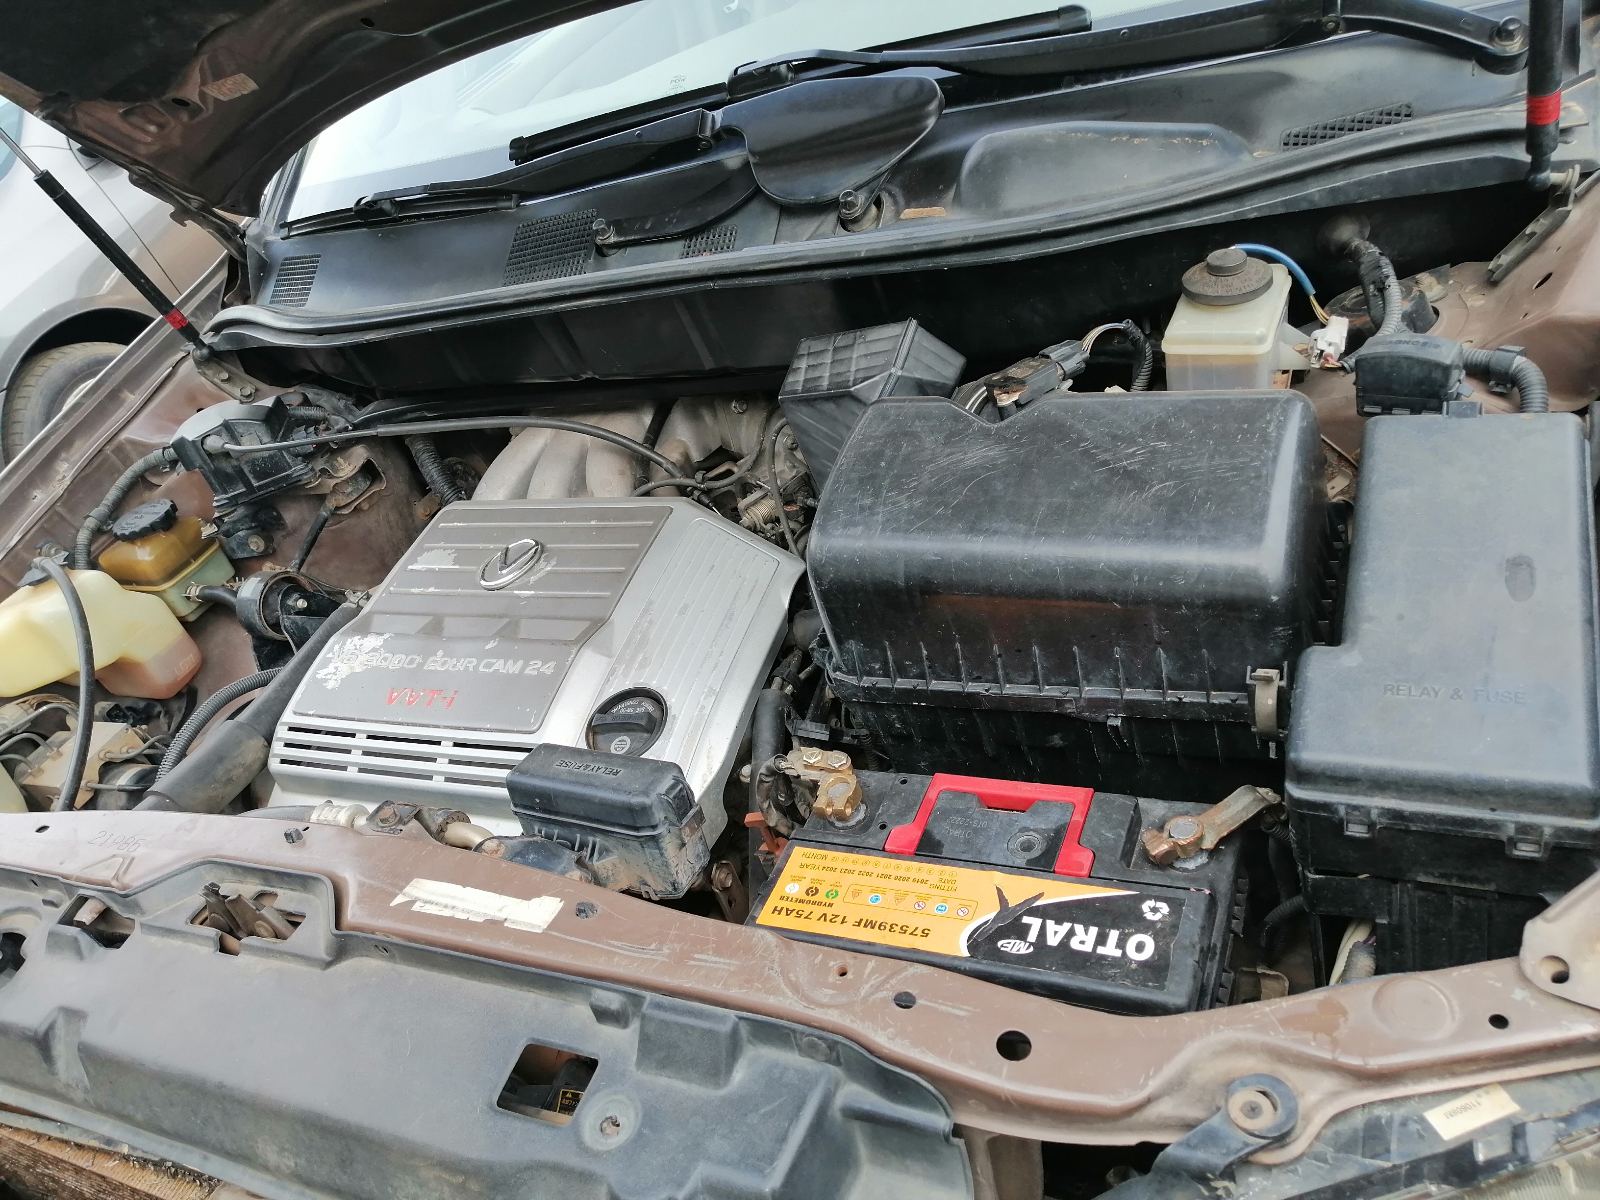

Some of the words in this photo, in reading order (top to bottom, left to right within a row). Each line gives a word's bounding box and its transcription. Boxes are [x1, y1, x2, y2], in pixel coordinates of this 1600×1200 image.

[424, 656, 475, 672] FOUR
[478, 658, 520, 674] CAM
[524, 660, 557, 676] 24
[1383, 684, 1443, 699] RELAY
[1449, 687, 1464, 701] &
[1473, 688, 1528, 704] FUSE
[801, 850, 828, 861] MONTH
[799, 862, 822, 871] YEAR
[876, 872, 893, 880] 2021
[936, 876, 957, 885] DATE
[928, 882, 958, 893] FITTING
[778, 894, 834, 909] HYDROMETER
[771, 904, 814, 921] 75AH
[816, 912, 848, 925] 12V
[852, 917, 931, 938] 57539MF
[1020, 915, 1155, 962] OTRAL
